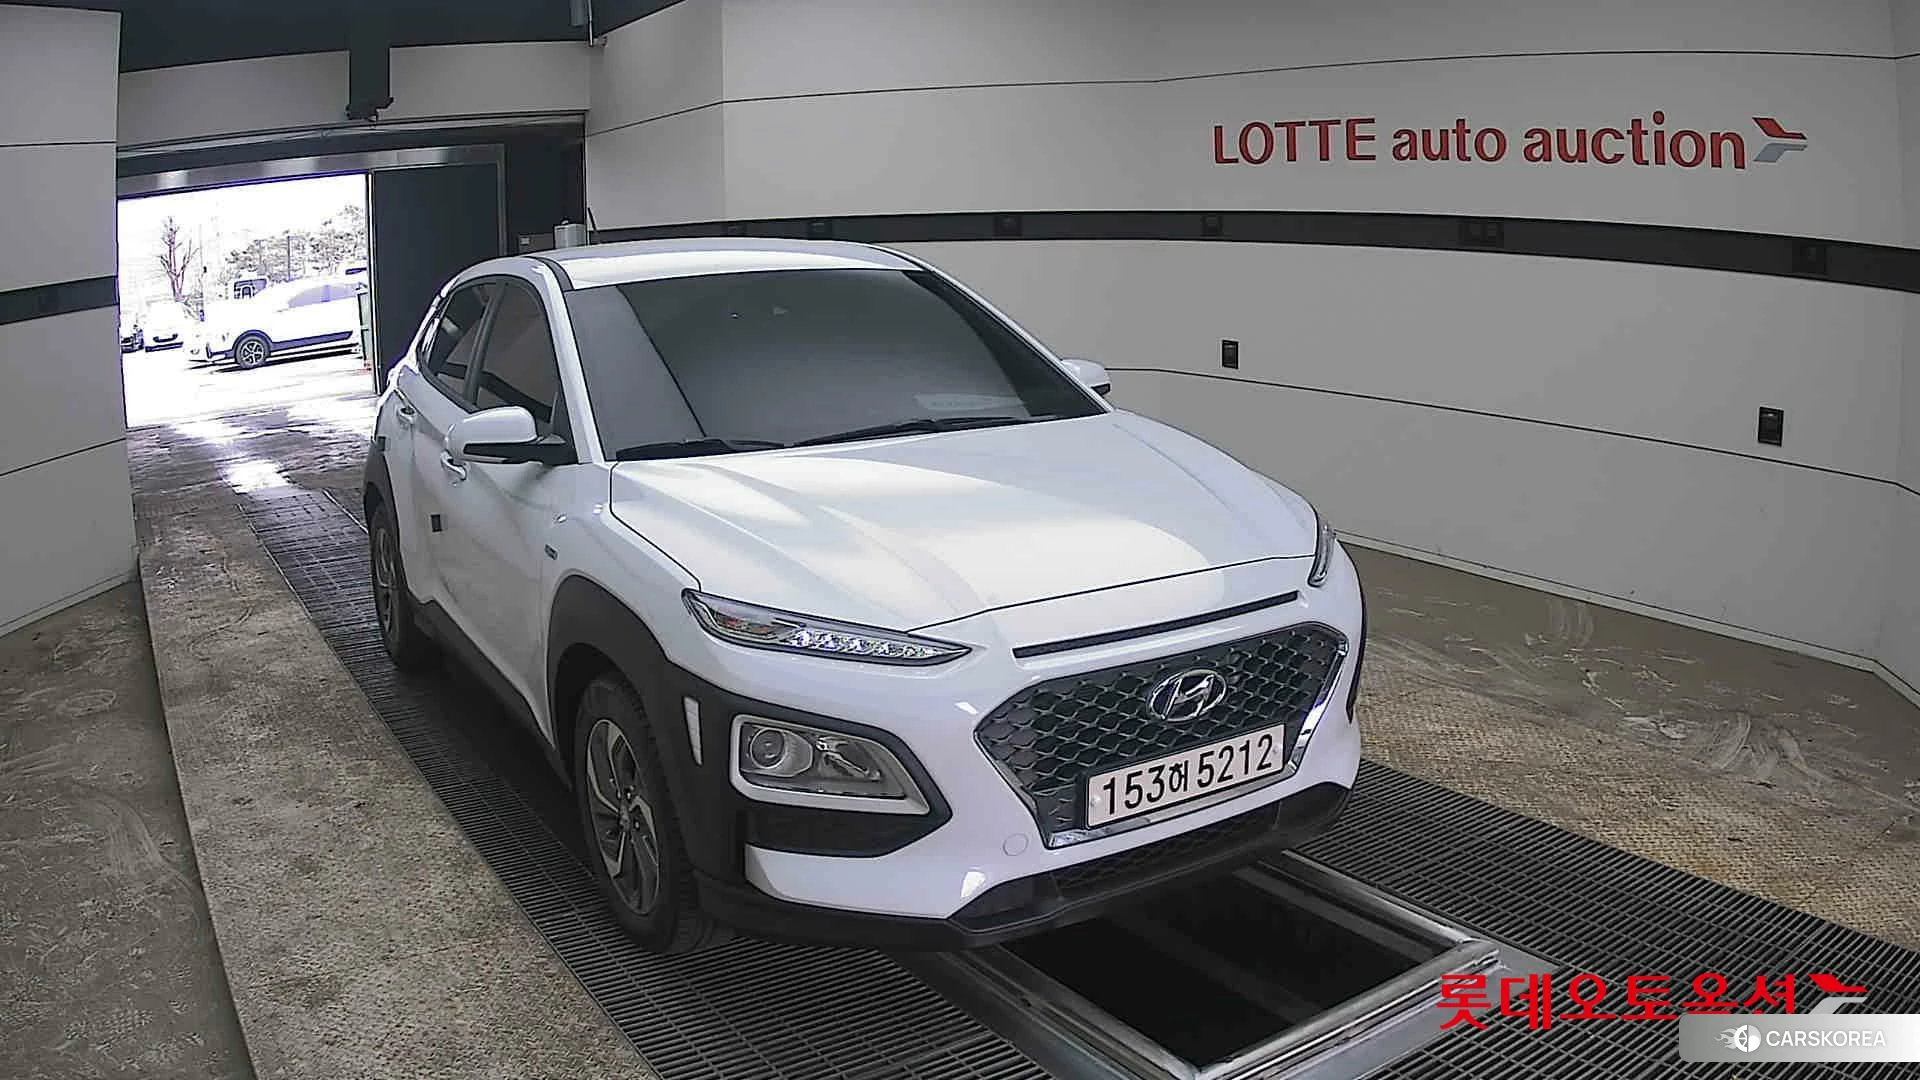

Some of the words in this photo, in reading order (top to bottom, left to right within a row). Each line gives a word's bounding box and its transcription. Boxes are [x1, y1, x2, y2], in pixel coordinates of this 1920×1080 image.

[1213, 118, 1377, 165] LOTTE
[1392, 118, 1508, 162] auto
[1522, 111, 1746, 169] auction
[1103, 760, 1189, 815] 153허
[1197, 734, 1273, 788] 5212
